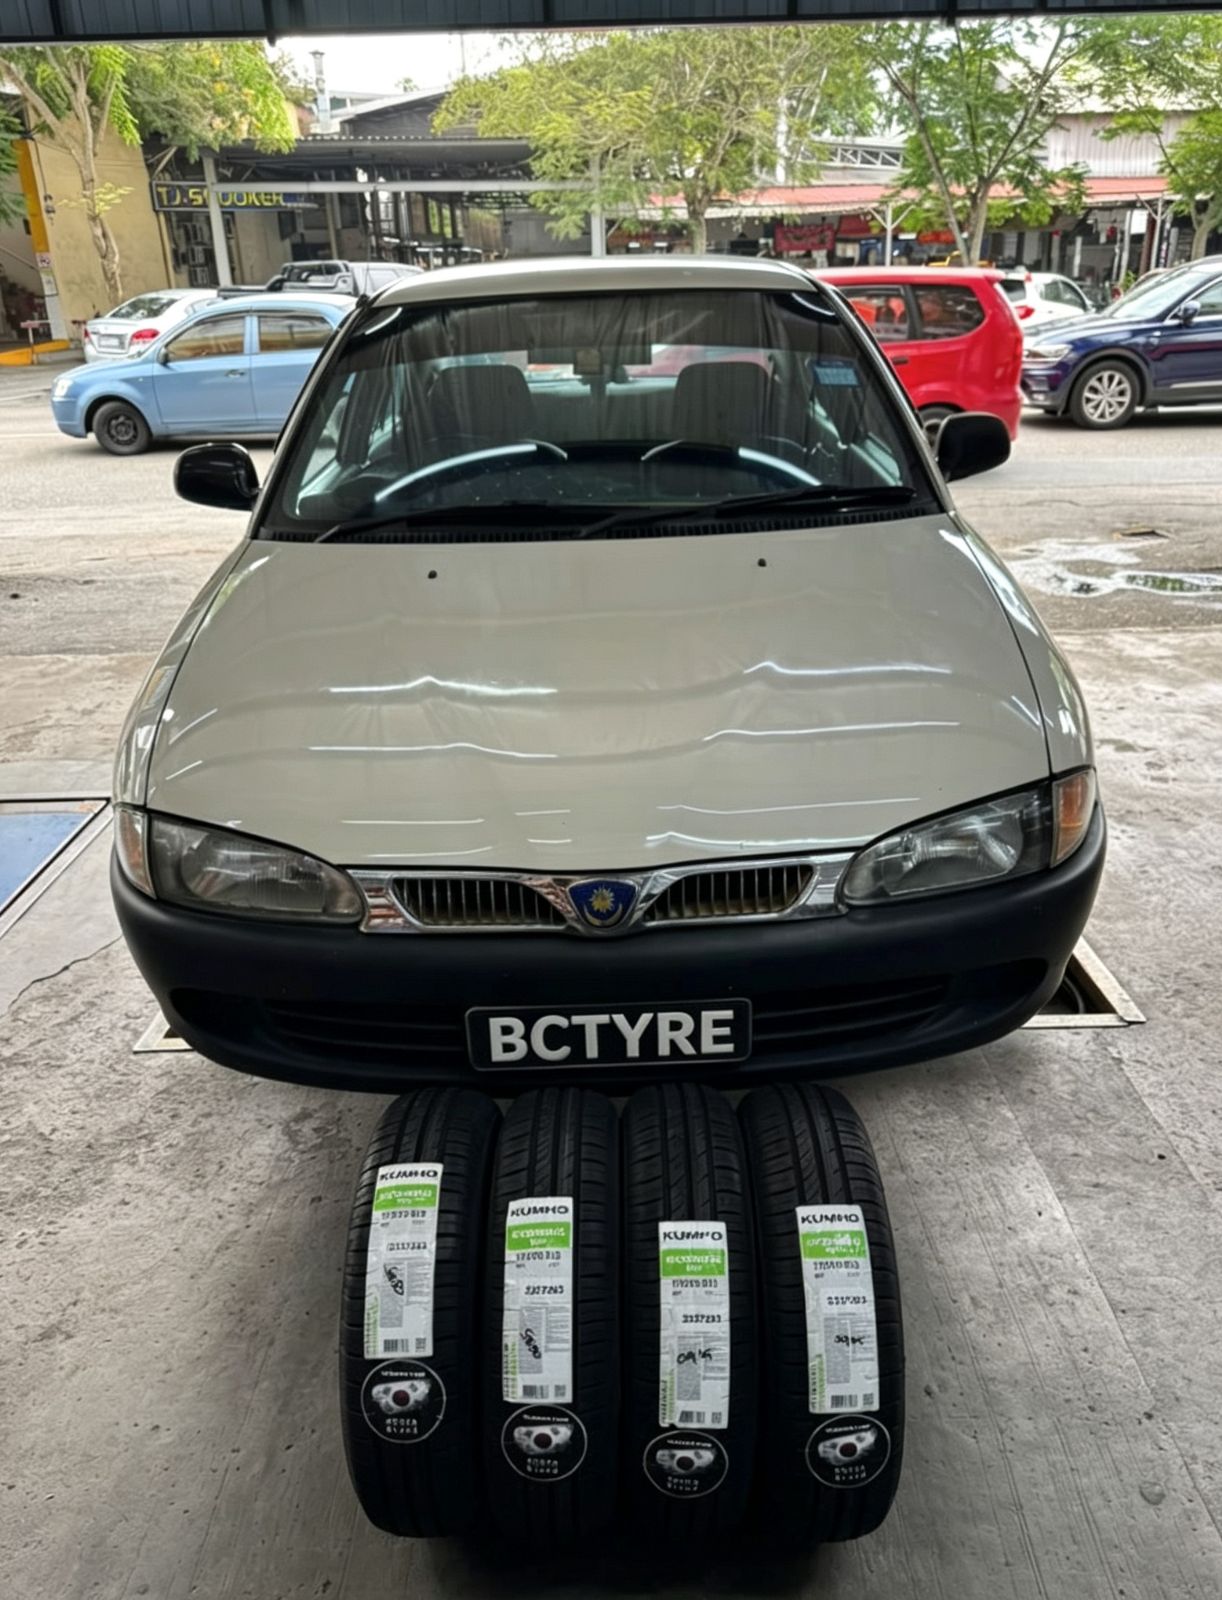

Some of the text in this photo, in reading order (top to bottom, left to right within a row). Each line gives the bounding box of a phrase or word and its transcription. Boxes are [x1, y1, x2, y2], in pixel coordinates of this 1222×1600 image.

[489, 1010, 734, 1062] BCTYRE
[510, 1205, 569, 1217] KUMHO
[801, 1213, 860, 1224] KUMHO
